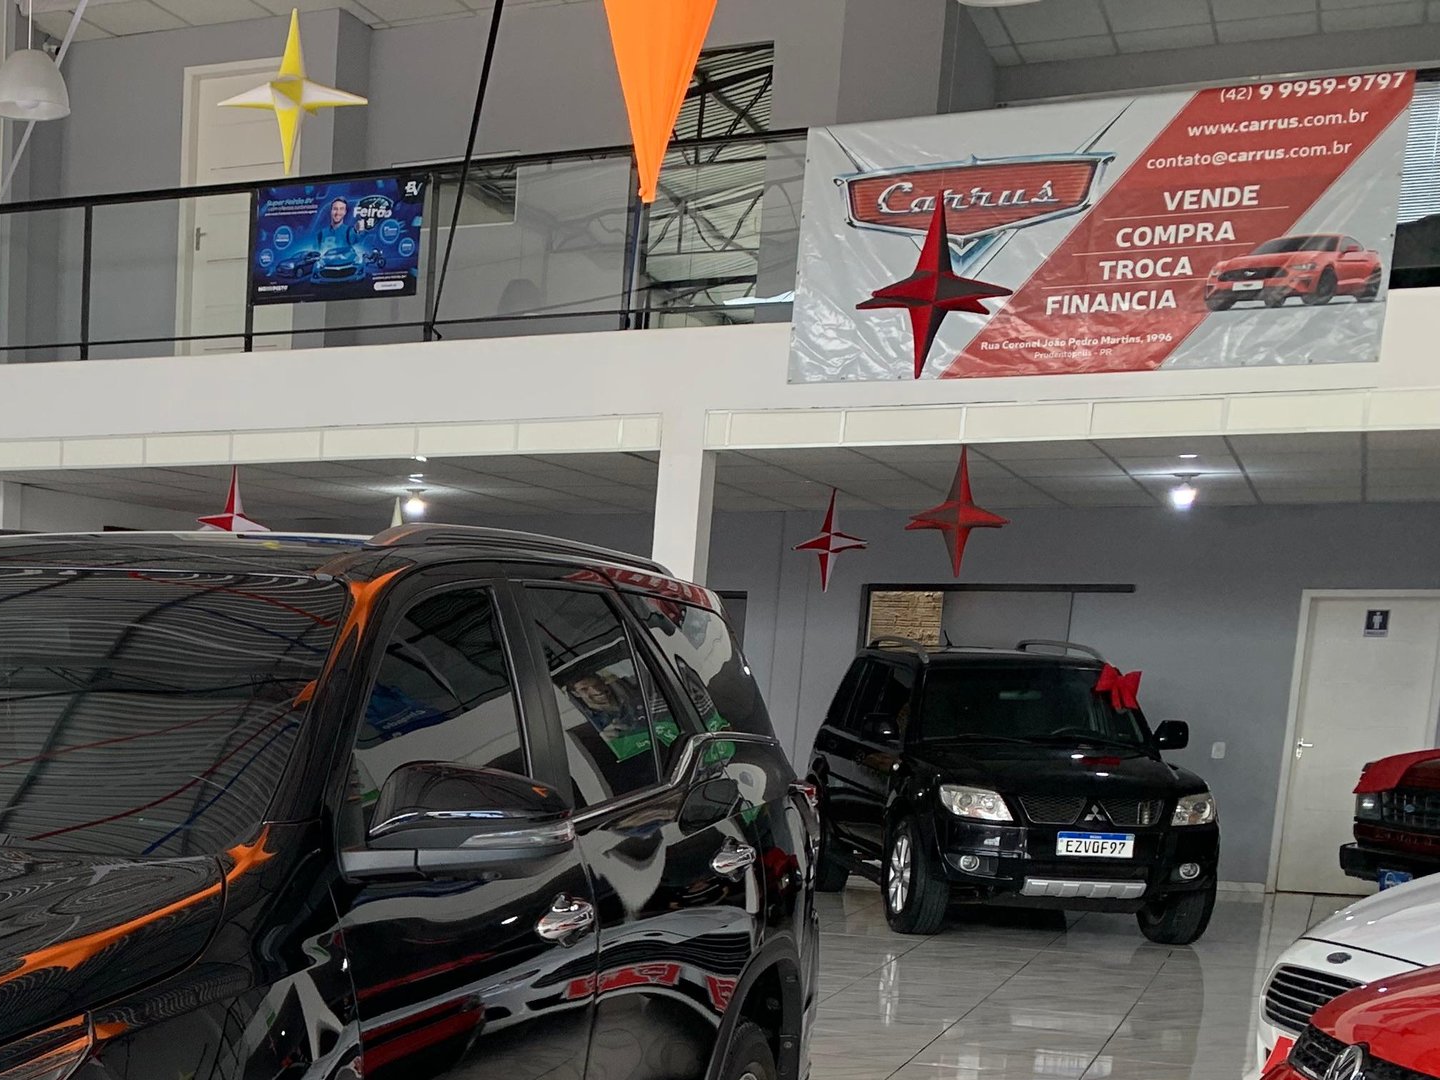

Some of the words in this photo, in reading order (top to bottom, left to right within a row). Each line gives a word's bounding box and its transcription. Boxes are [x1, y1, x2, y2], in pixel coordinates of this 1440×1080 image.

[1220, 86, 1253, 103] (42)
[1259, 84, 1274, 100] 9
[1279, 72, 1407, 98] 9959-9797
[1187, 109, 1369, 137] www.carrus.com.br
[1146, 141, 1352, 169] contato@carrus.com.br
[877, 180, 1060, 214] Carrus
[1163, 185, 1261, 211] VENDE
[353, 204, 393, 218] Feirão
[1116, 221, 1236, 248] COMPRA
[1099, 256, 1193, 280] TROCA
[1045, 289, 1177, 315] FINANCIA
[980, 341, 1000, 351] Rua
[1002, 339, 1040, 350] Coronel
[1042, 337, 1066, 348] João
[1068, 337, 1099, 347] Pedro
[1101, 334, 1143, 346] Martins,
[1146, 333, 1173, 343] 1996
